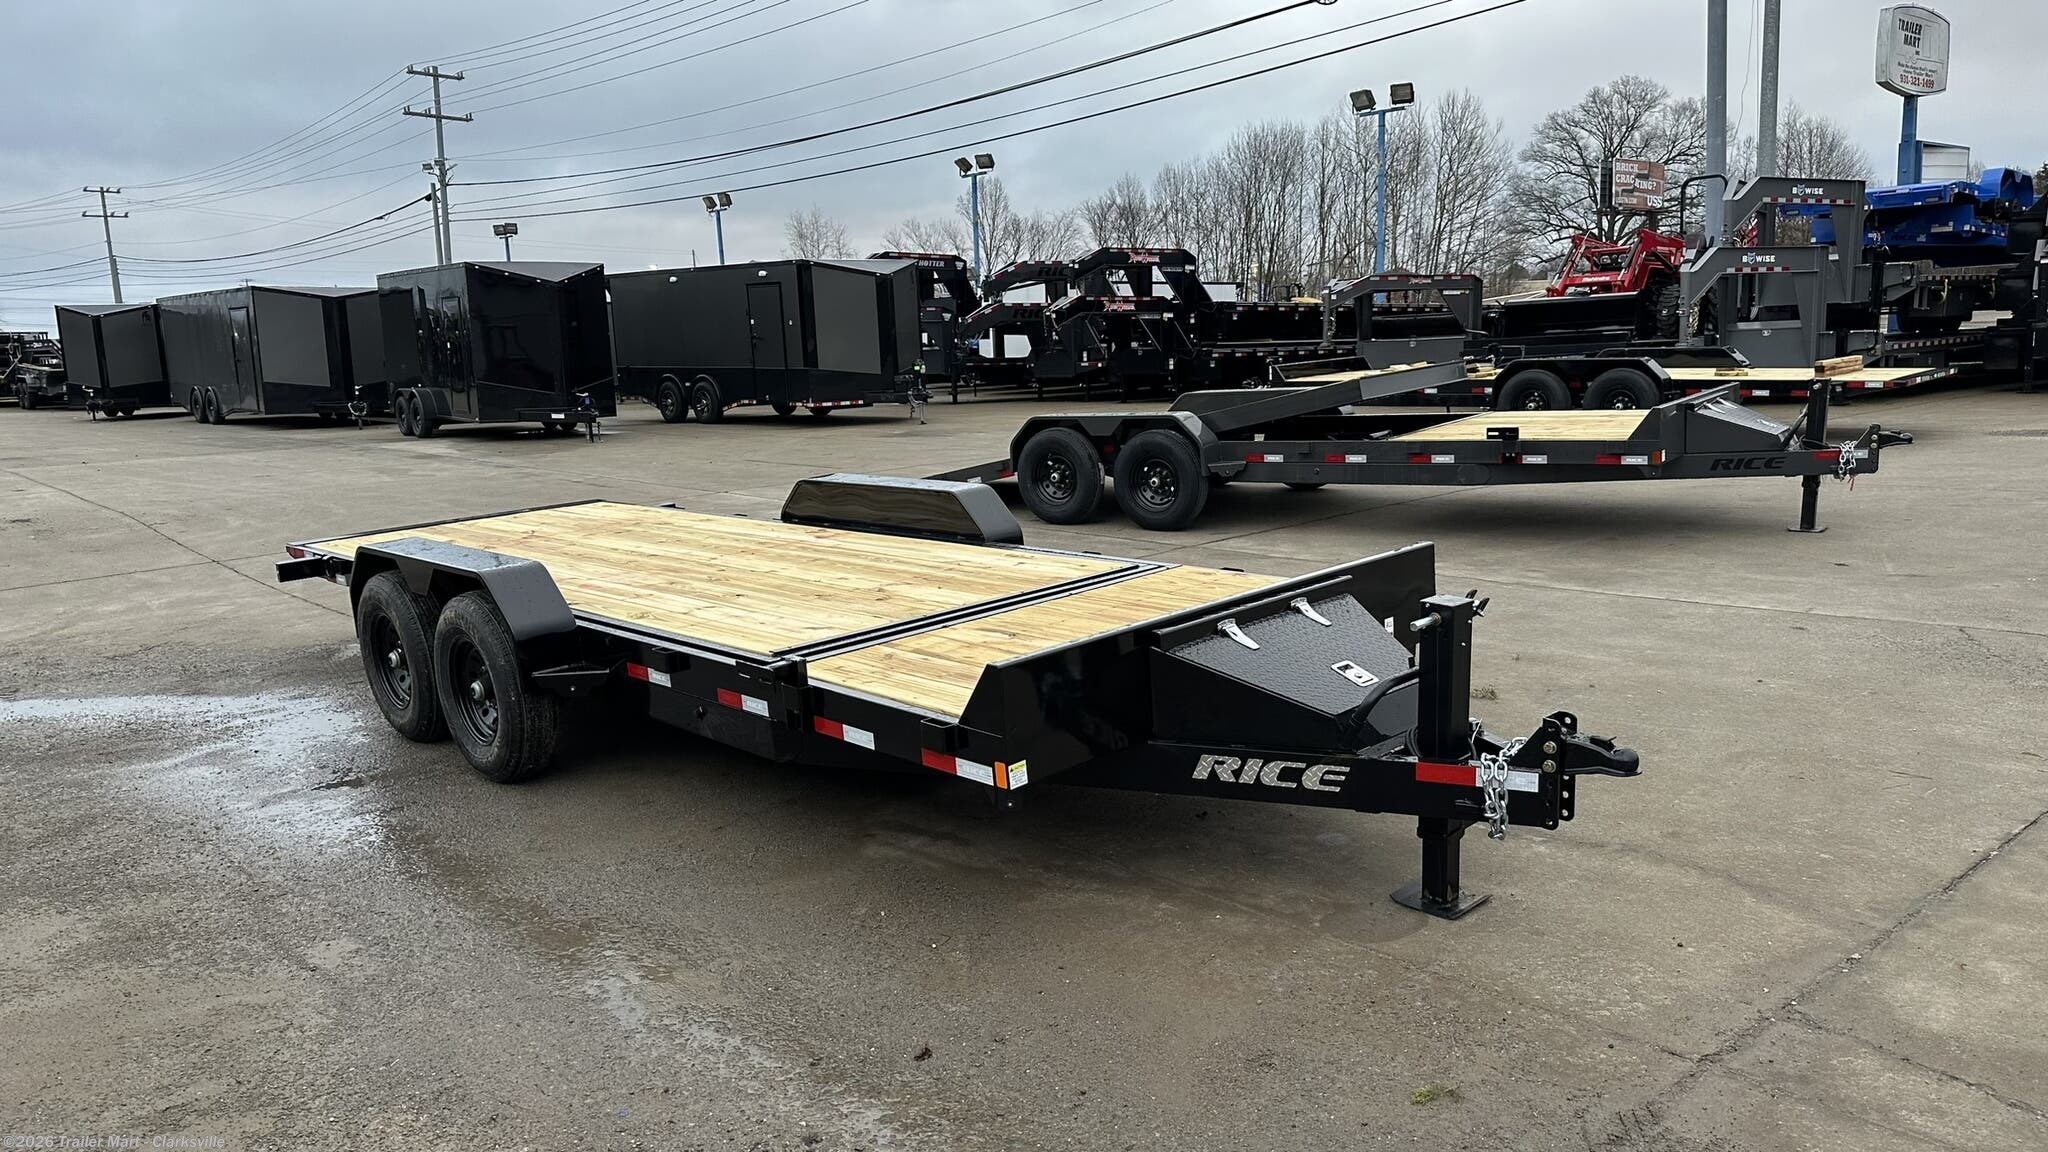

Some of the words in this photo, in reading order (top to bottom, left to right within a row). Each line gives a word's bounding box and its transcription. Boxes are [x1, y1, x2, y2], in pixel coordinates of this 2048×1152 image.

[1898, 18, 1922, 36] TRAILER
[1903, 33, 1921, 49] MART
[1647, 195, 1663, 208] USS
[1710, 456, 1787, 471] RICE
[1192, 754, 1350, 792] RICE
